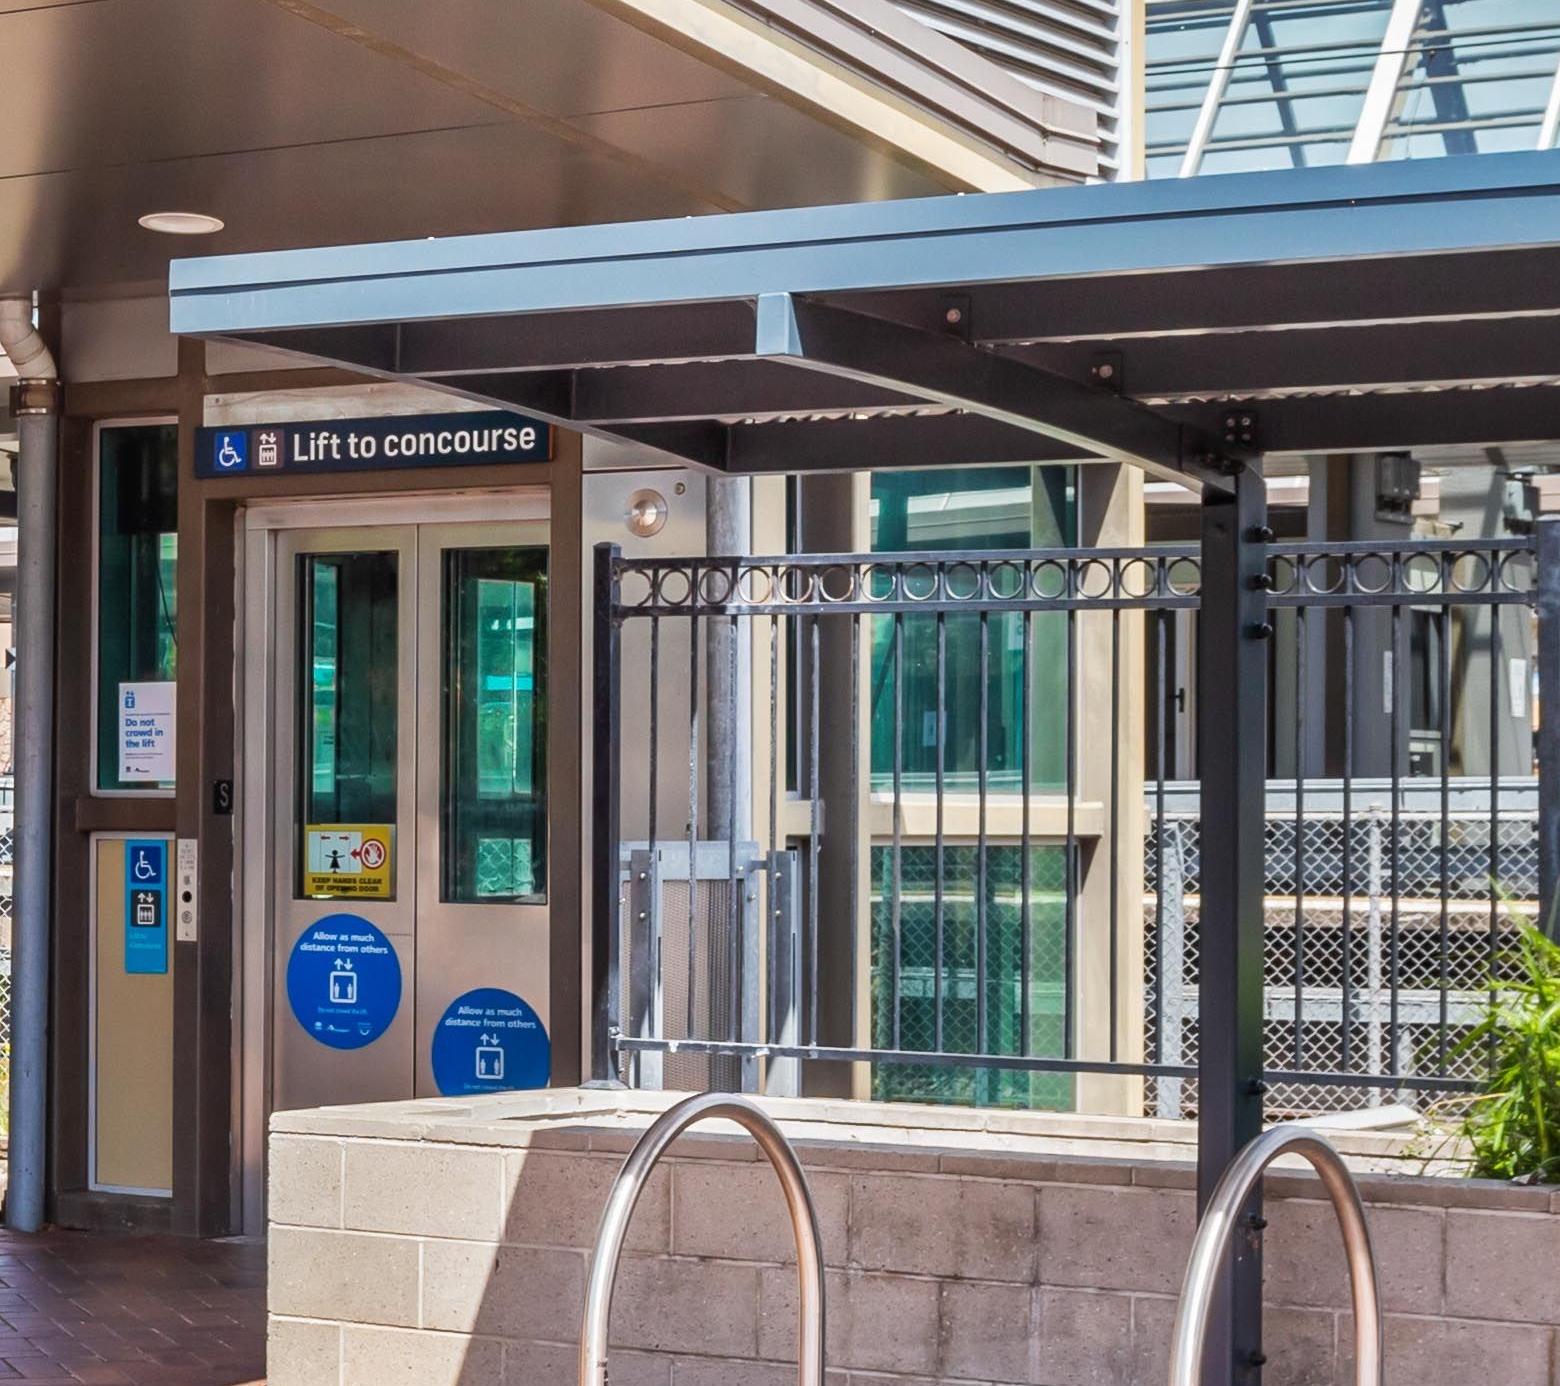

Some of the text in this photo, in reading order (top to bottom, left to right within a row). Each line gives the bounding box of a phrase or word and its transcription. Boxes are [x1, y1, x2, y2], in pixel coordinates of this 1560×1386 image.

[293, 426, 536, 461] Lift to concourse
[125, 718, 155, 727] Do not
[125, 728, 163, 737] crowd in
[125, 739, 155, 748] the lift
[313, 931, 338, 941] Allow
[351, 933, 374, 942] much
[300, 942, 388, 954] distance from others
[457, 1005, 484, 1015] Allow
[497, 1007, 522, 1017] much
[445, 1017, 536, 1029] distance from others
